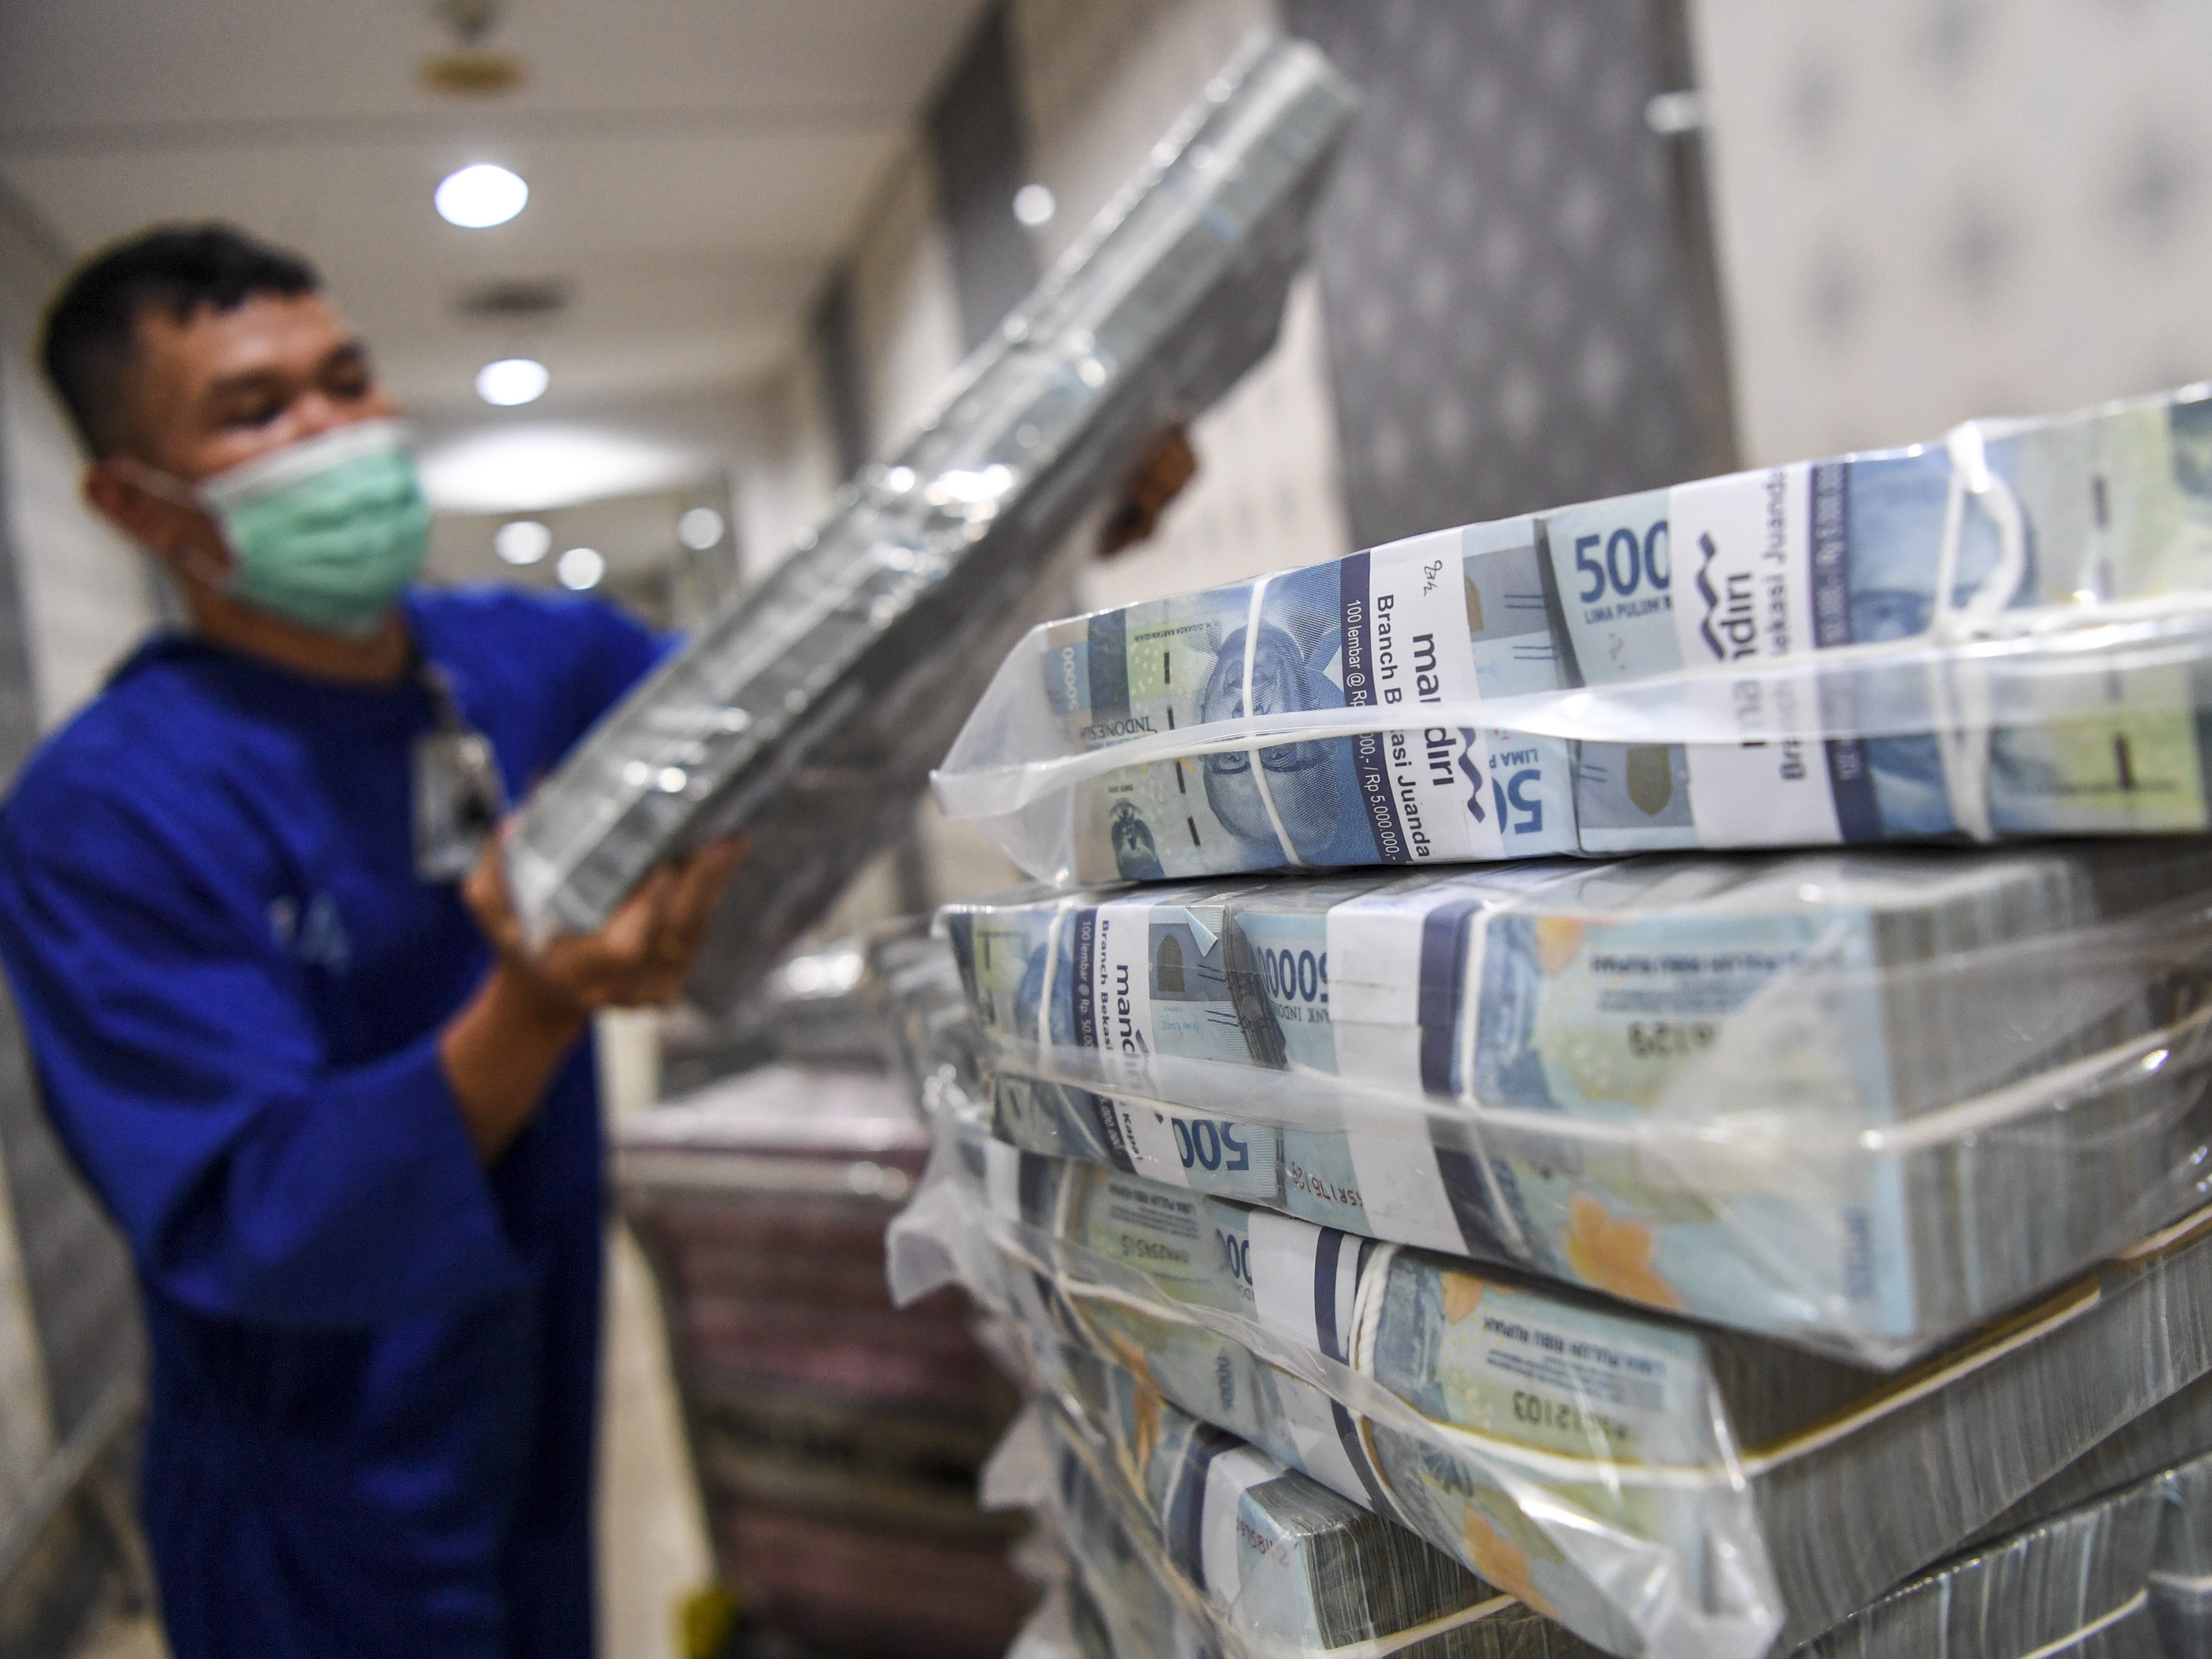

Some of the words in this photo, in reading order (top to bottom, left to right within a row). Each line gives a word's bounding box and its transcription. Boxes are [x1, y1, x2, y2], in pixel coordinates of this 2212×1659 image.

[1346, 600, 1361, 623] 100
[1377, 594, 1398, 680] Branch
[1348, 625, 1363, 669] lembar
[1346, 673, 1365, 688] @
[1383, 687, 1412, 767] Basi
[1413, 633, 1457, 785] madiri
[1364, 773, 1381, 793] Rp
[1501, 748, 1539, 767] LIMA
[1370, 795, 1401, 861] 5.000.000,-
[1398, 775, 1430, 858] Juanda
[1081, 921, 1091, 940] 100
[1100, 920, 1109, 985] Branch
[1079, 943, 1091, 979] lembar
[1100, 992, 1114, 1050] Bekasi
